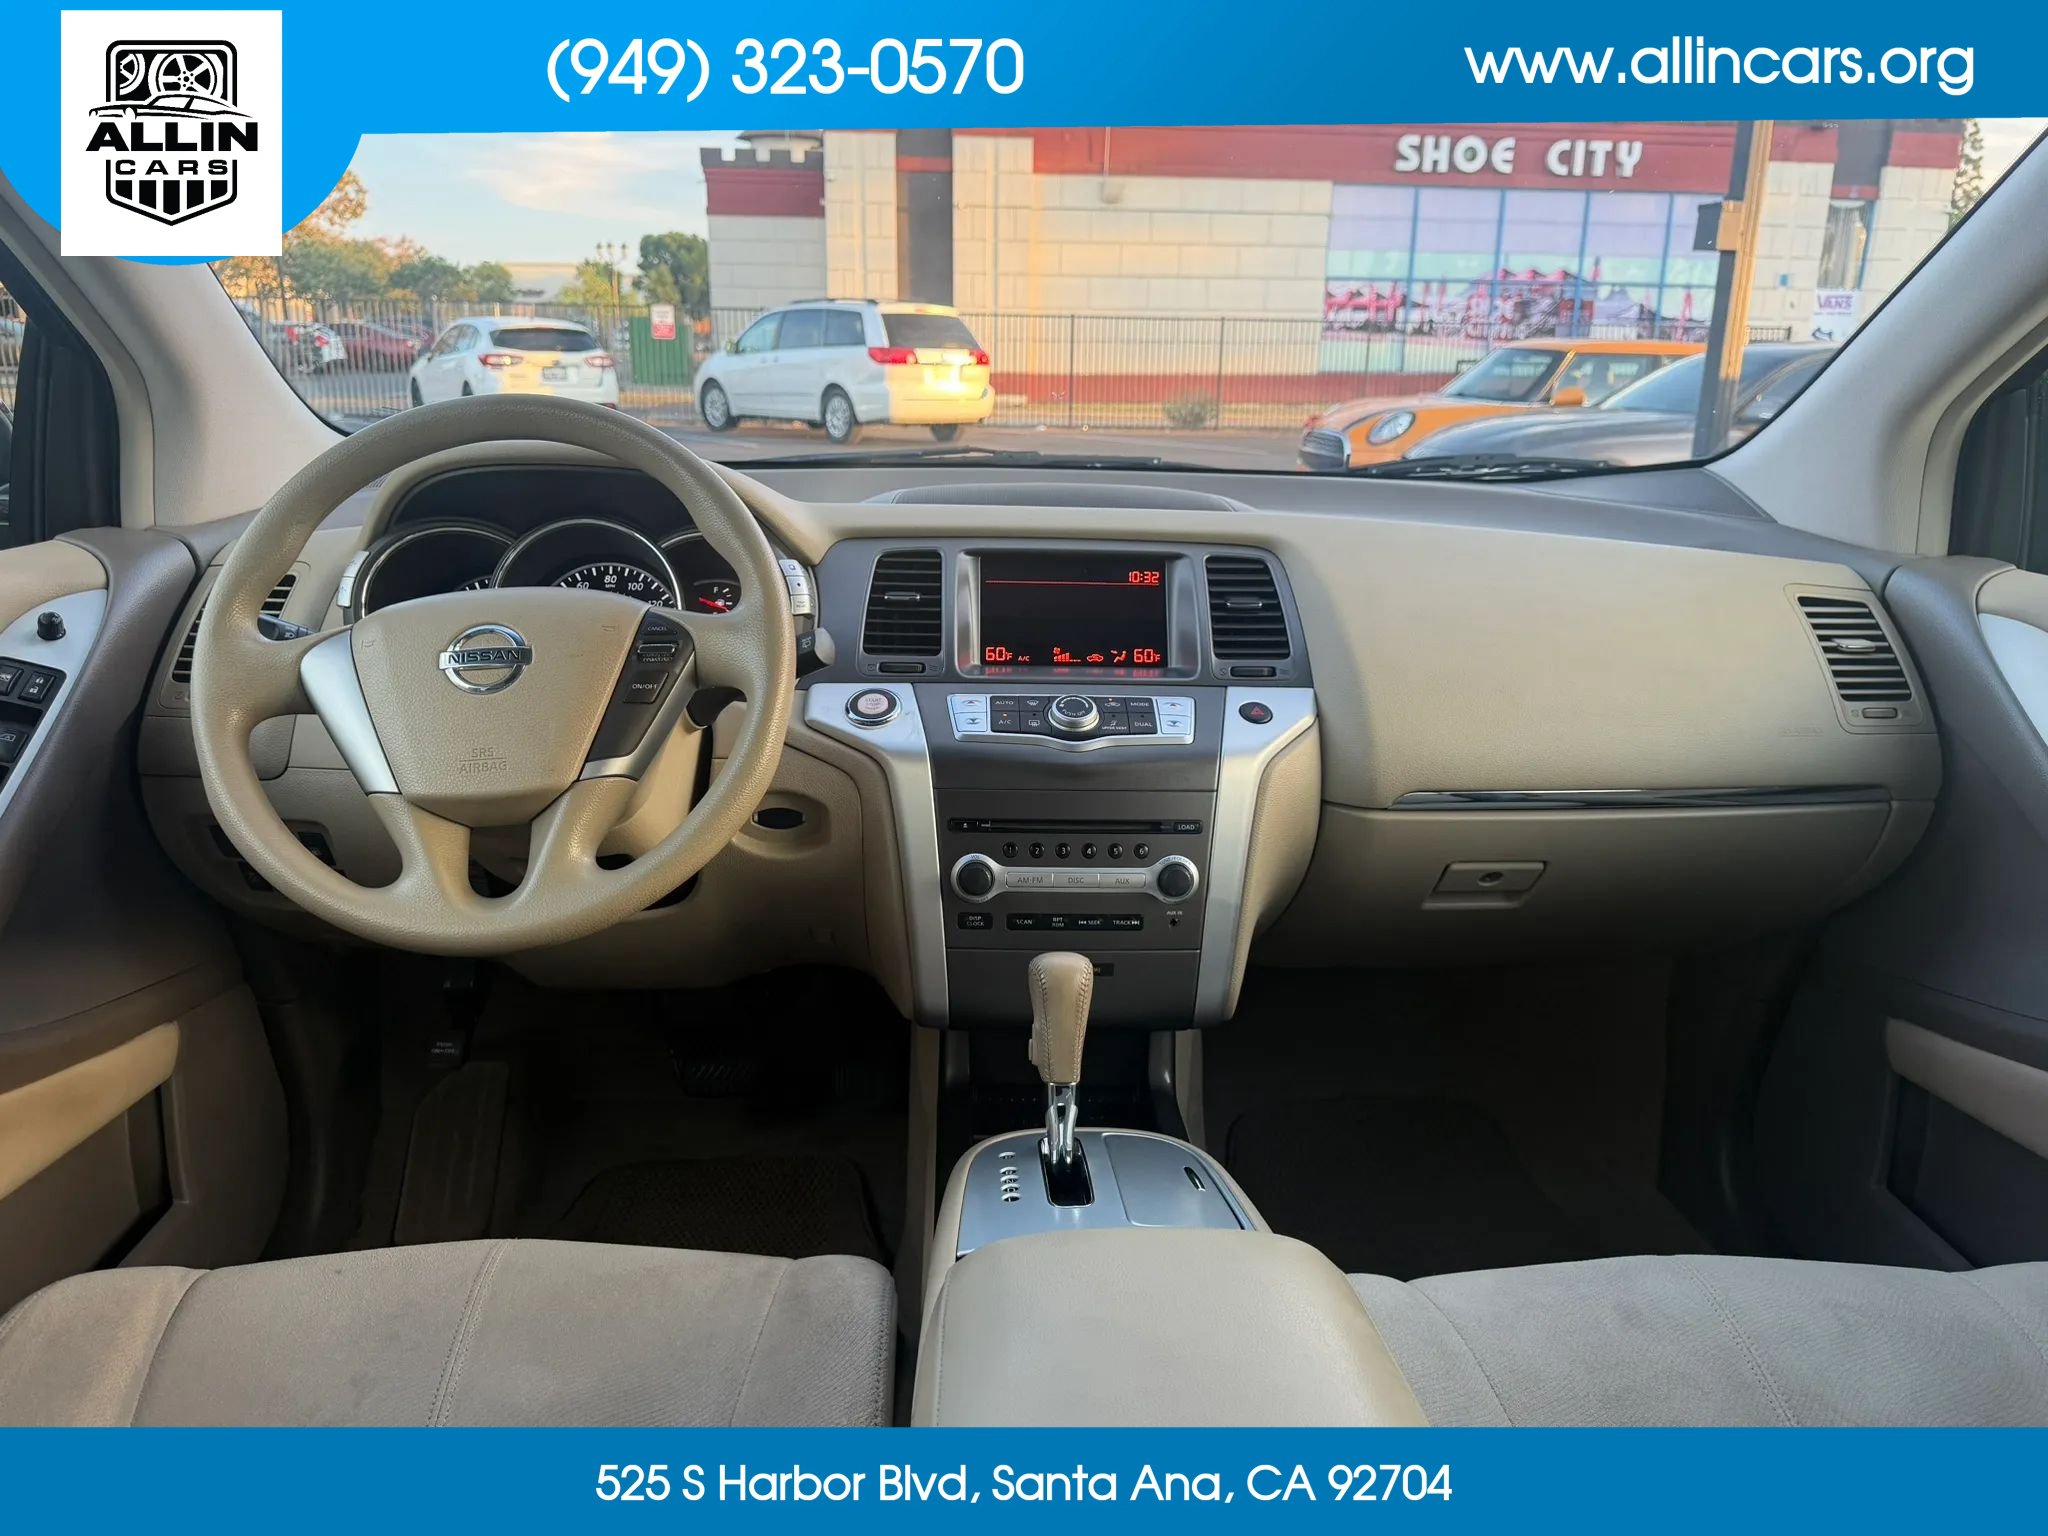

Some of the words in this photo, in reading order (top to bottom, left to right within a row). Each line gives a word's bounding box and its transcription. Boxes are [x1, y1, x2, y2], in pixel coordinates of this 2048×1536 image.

[1394, 134, 1516, 174] SHOE
[1546, 138, 1643, 178] CITY
[604, 575, 618, 584] 80
[1129, 571, 1160, 583] 10:32
[577, 582, 590, 590] 60
[628, 582, 644, 591] 100
[448, 649, 520, 665] NISSAN
[472, 747, 494, 758] SRS
[459, 761, 507, 774] AIRBAG
